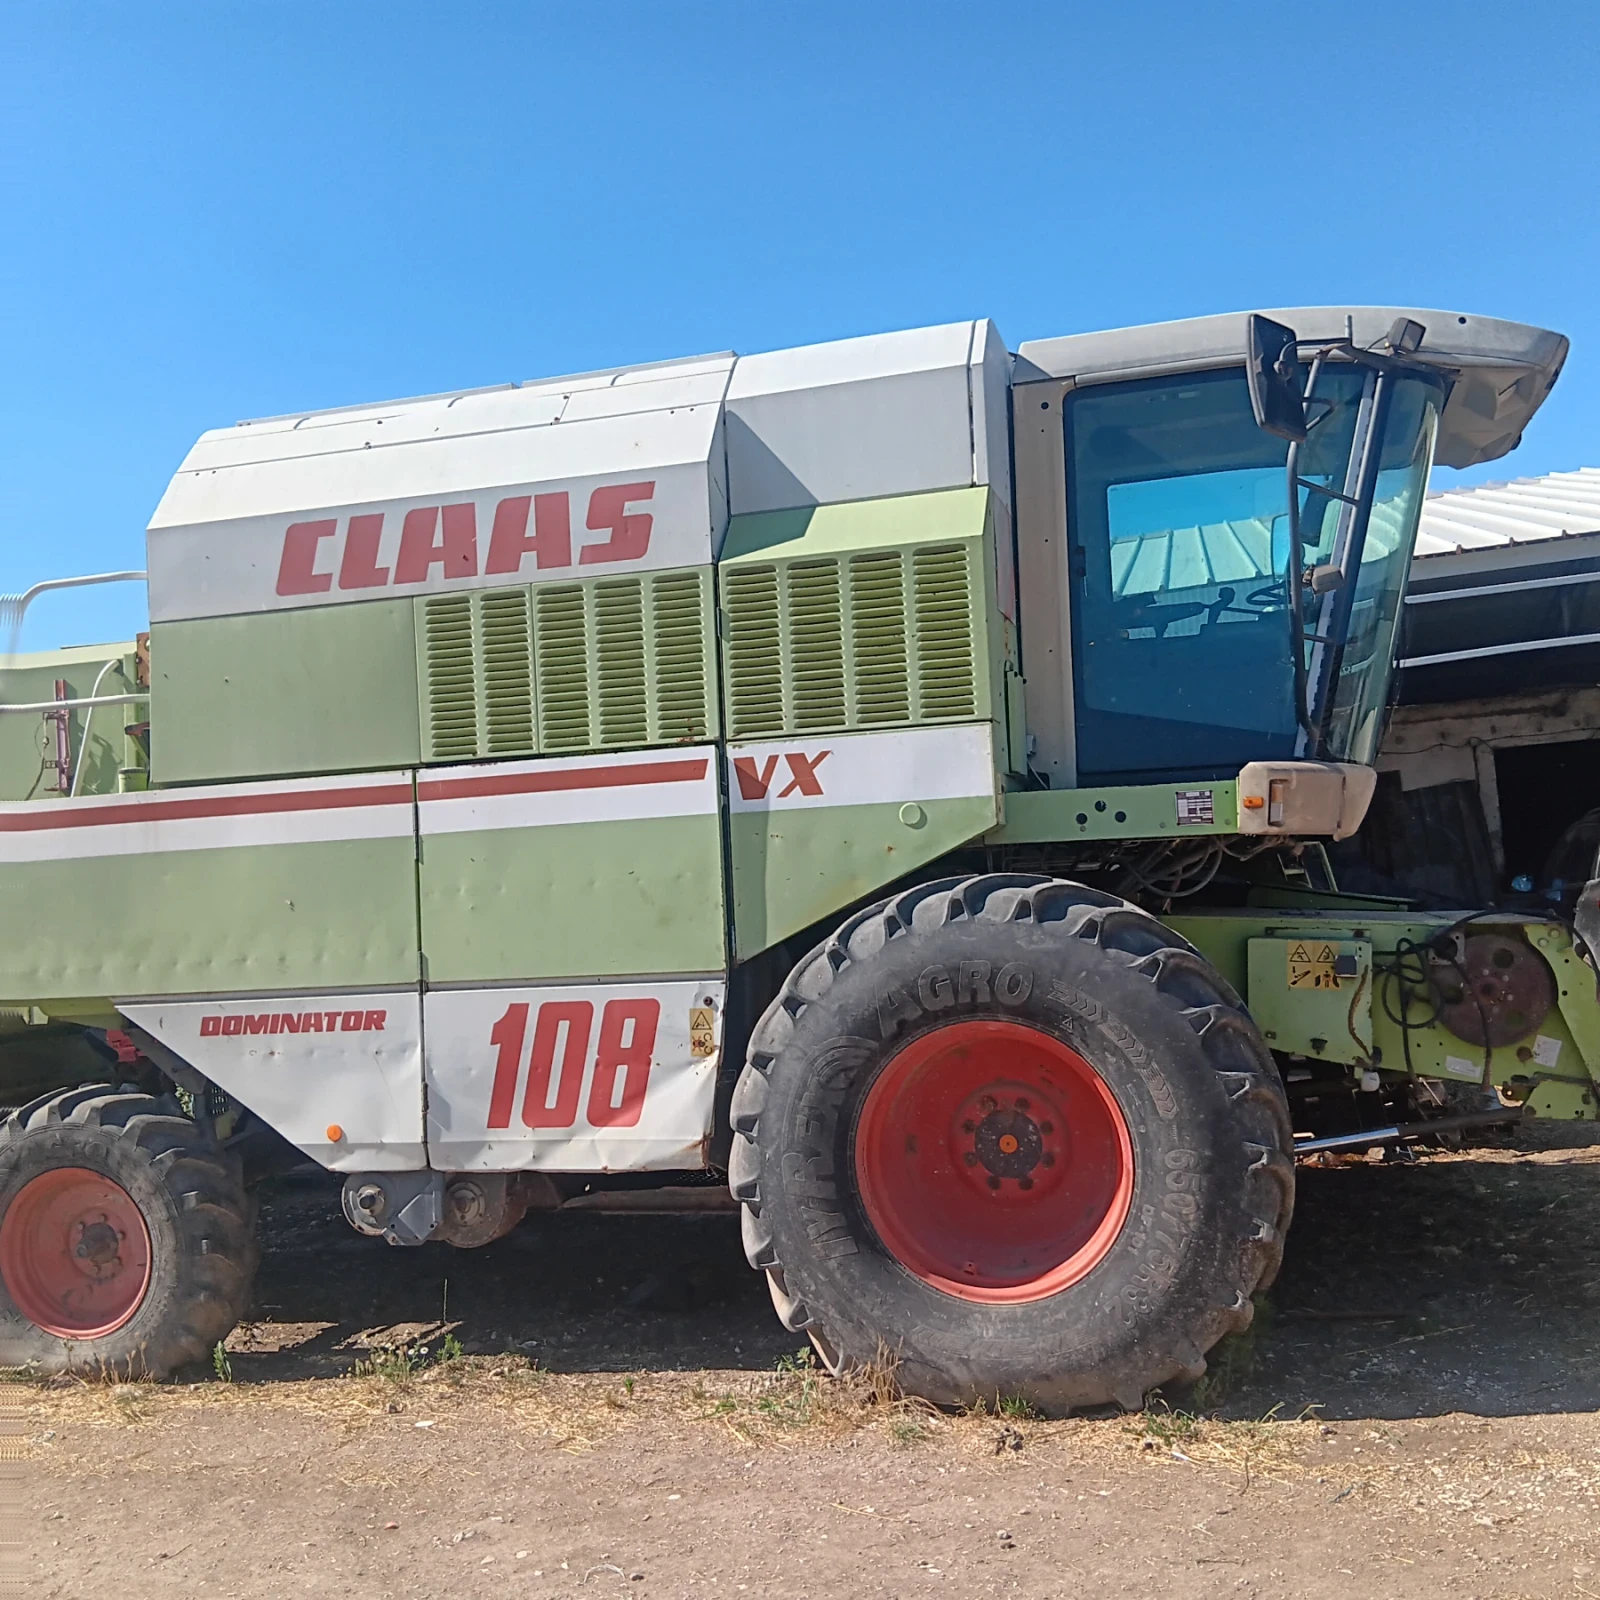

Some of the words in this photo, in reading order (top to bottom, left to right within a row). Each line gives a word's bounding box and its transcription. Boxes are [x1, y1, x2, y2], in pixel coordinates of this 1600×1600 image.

[275, 480, 656, 597] CLAAS
[733, 750, 832, 801] VX
[200, 1010, 387, 1037] DOMINATOR
[874, 959, 1034, 1040] AGRO
[486, 997, 661, 1129] 108
